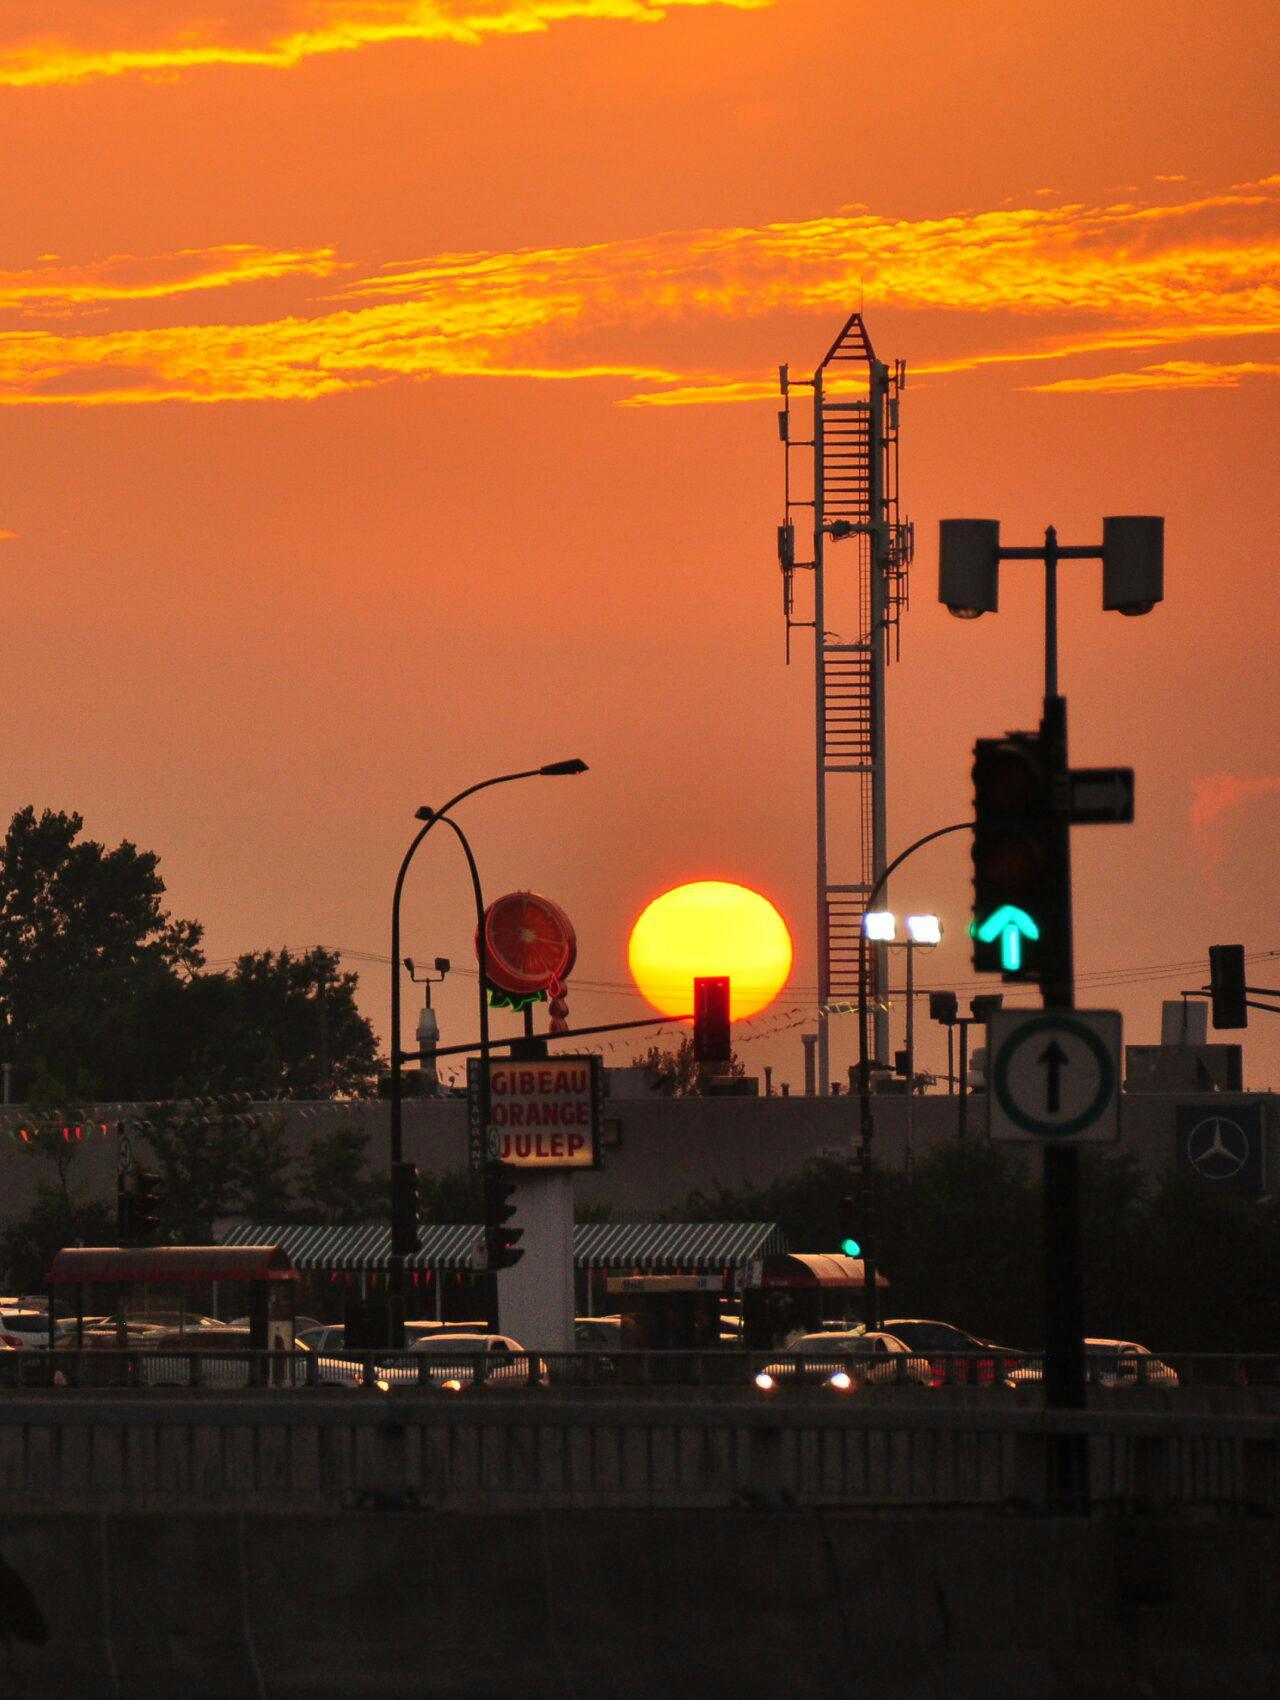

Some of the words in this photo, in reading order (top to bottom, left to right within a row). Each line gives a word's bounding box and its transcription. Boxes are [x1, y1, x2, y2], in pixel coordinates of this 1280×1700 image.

[491, 1070, 586, 1095] GIBEAU
[490, 1101, 589, 1126] ORANGE
[500, 1133, 585, 1158] JULEP
